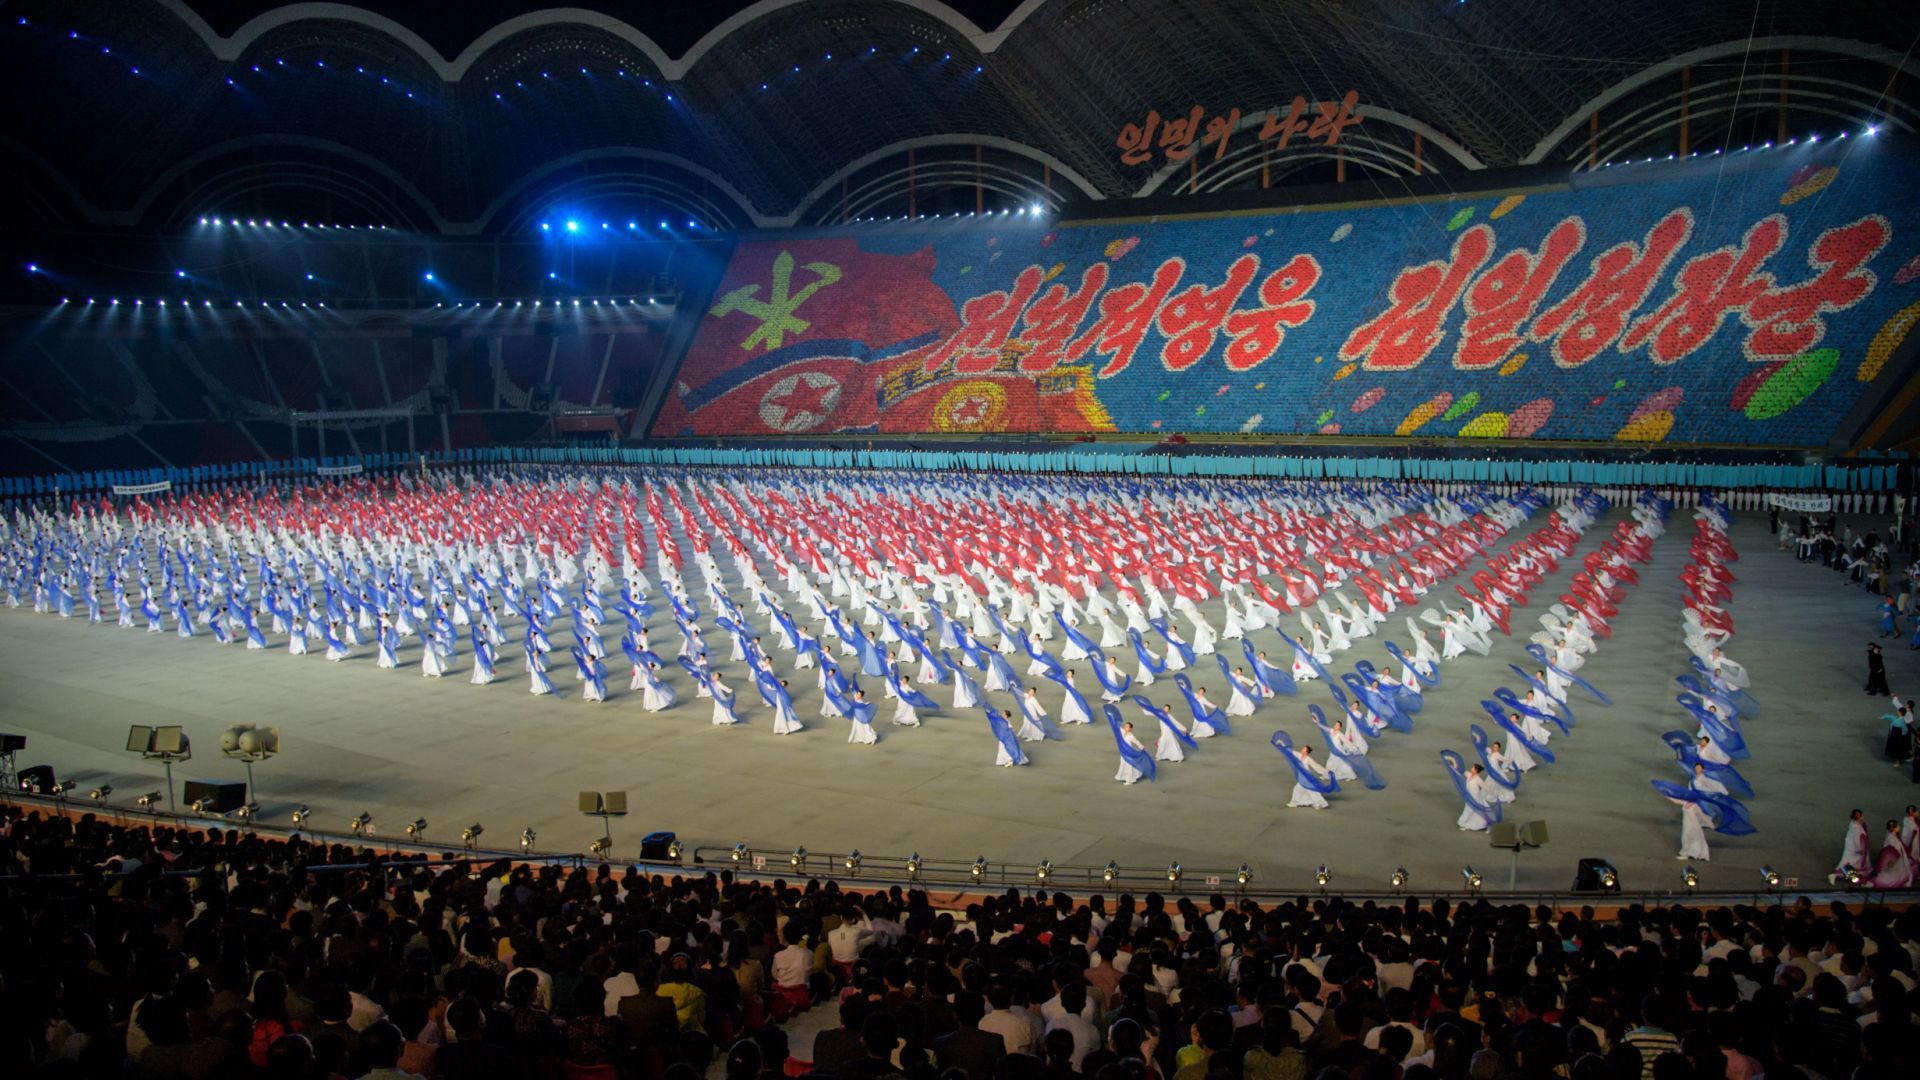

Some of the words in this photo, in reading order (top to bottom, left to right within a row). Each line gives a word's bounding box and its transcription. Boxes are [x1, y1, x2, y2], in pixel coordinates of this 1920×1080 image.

[1116, 104, 1241, 165] 인민의
[1259, 89, 1364, 150] 나라
[1337, 206, 1892, 371] 김일성장군
